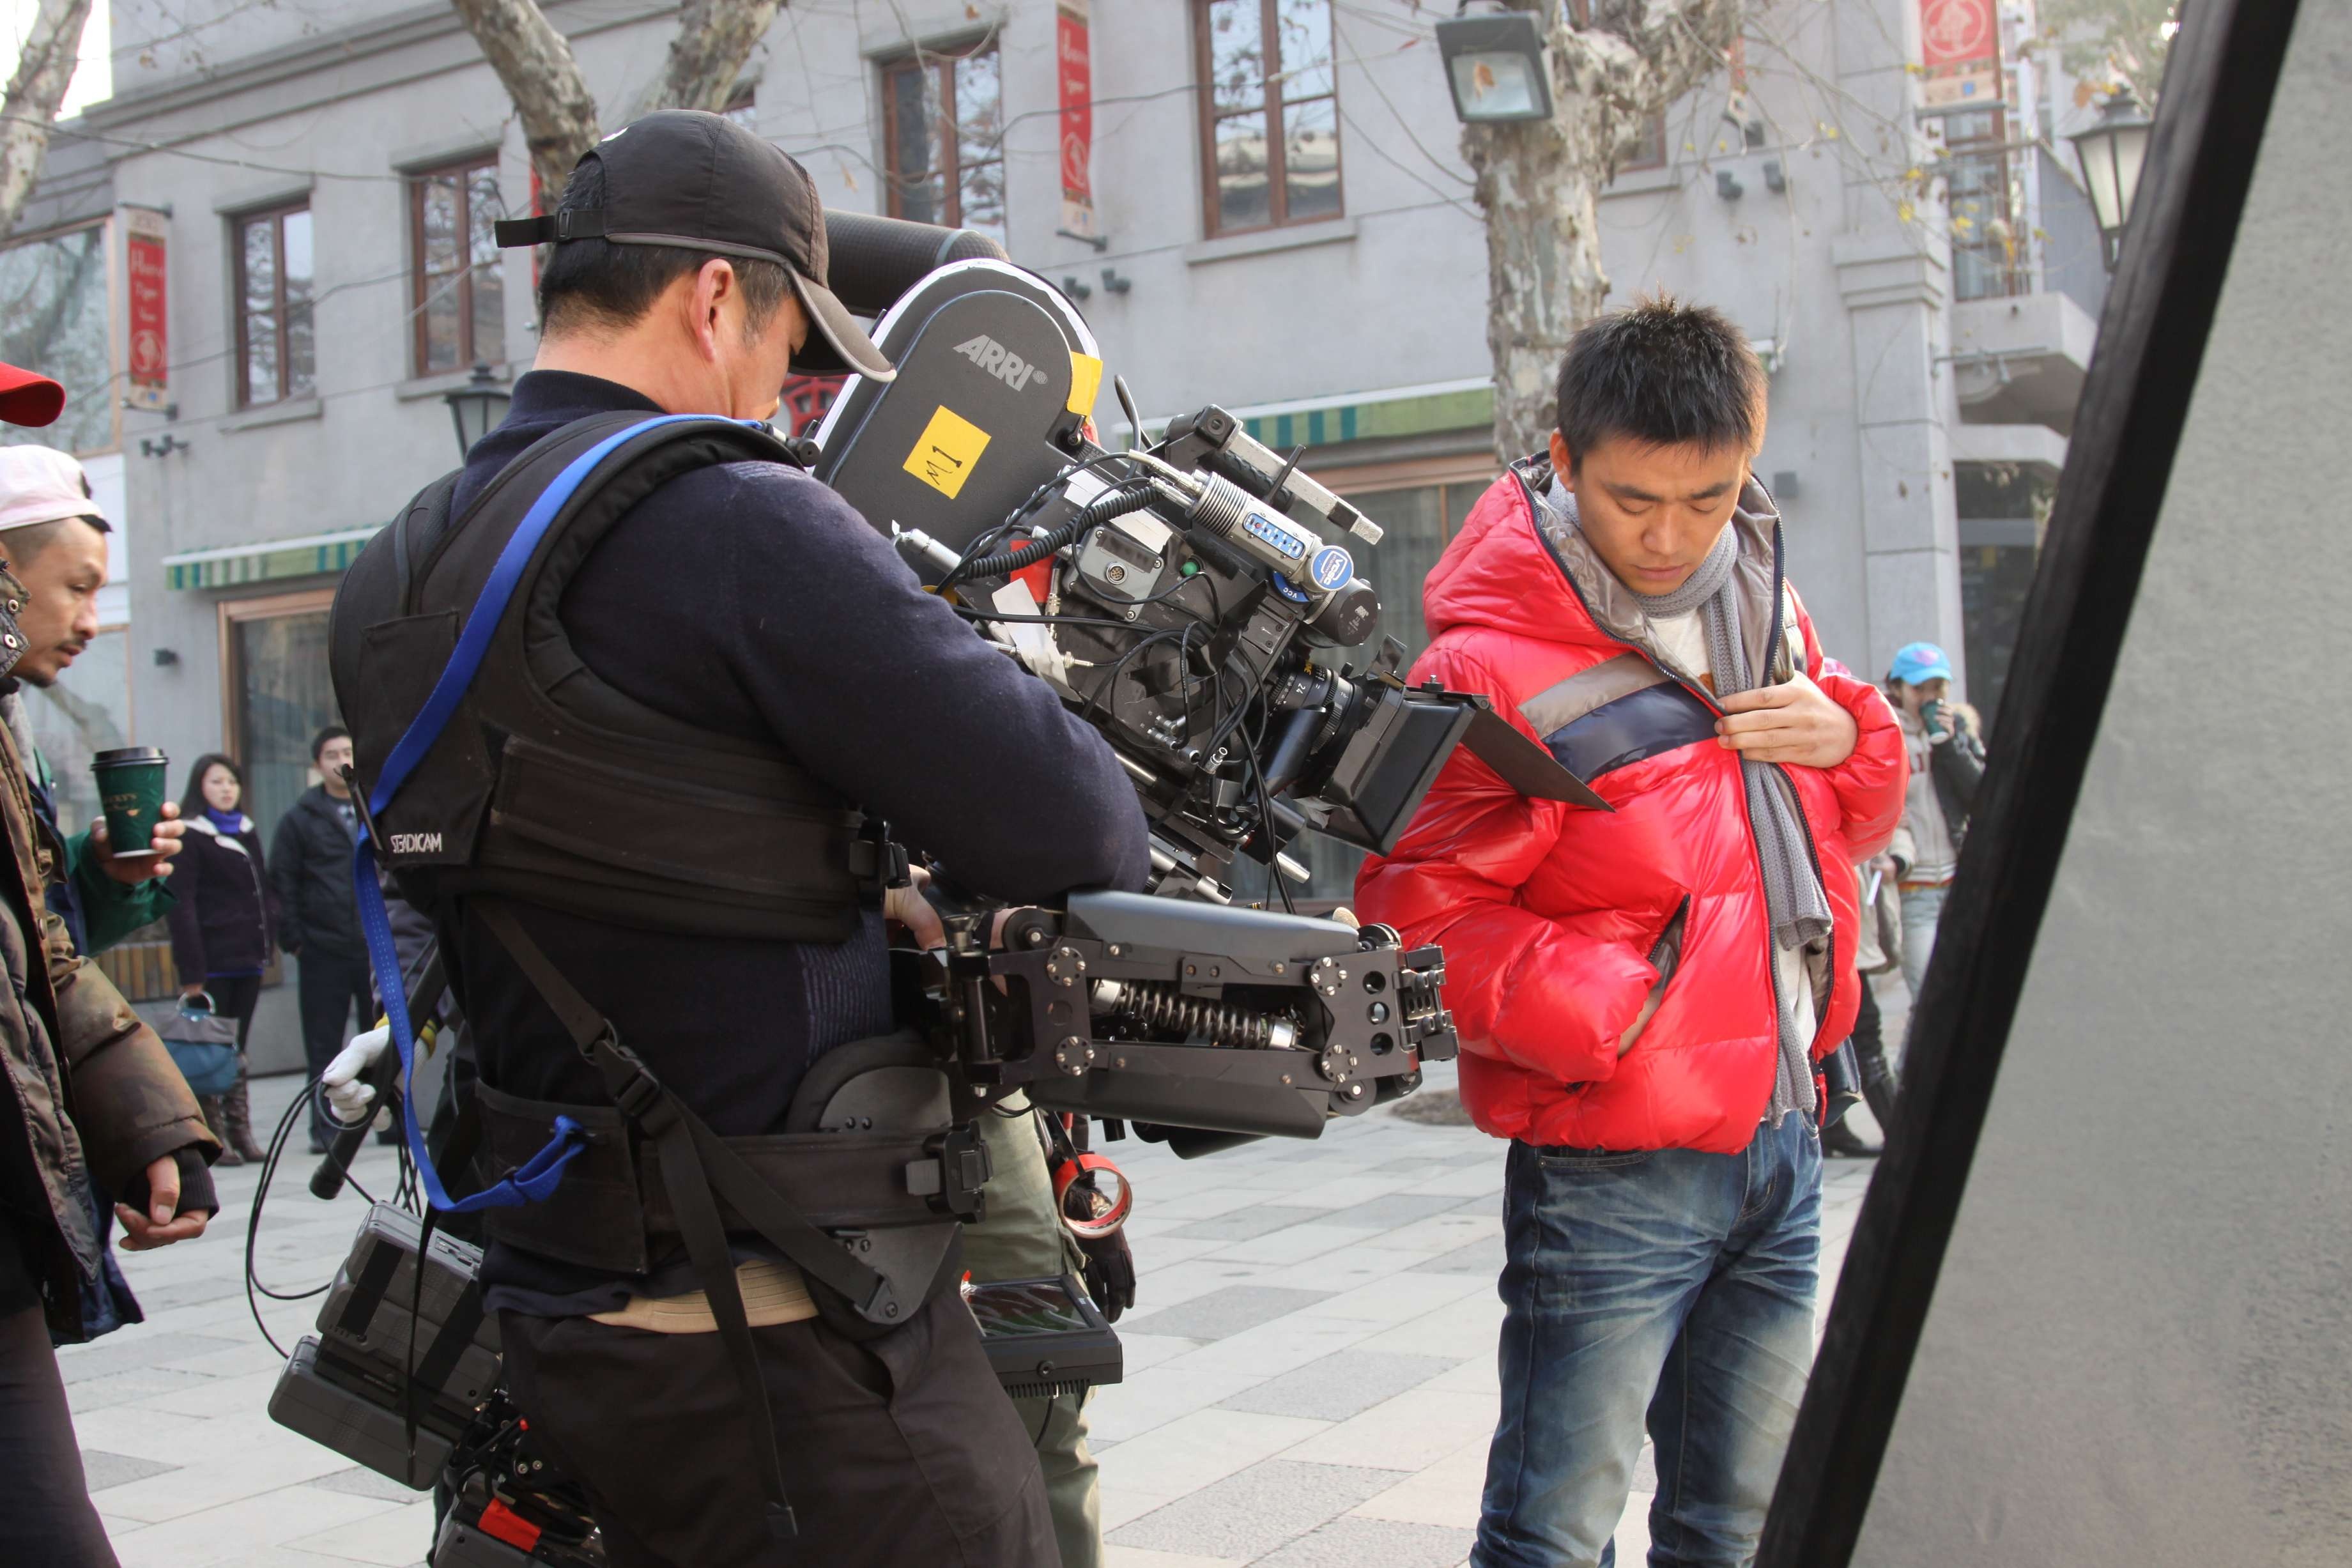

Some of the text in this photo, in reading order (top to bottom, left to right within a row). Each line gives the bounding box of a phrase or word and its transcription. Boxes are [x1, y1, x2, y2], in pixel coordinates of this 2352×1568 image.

[952, 334, 1035, 392] ARRI
[1282, 587, 1298, 599] VCC
[1296, 682, 1306, 695] 24
[390, 832, 442, 854] STEADICAM
